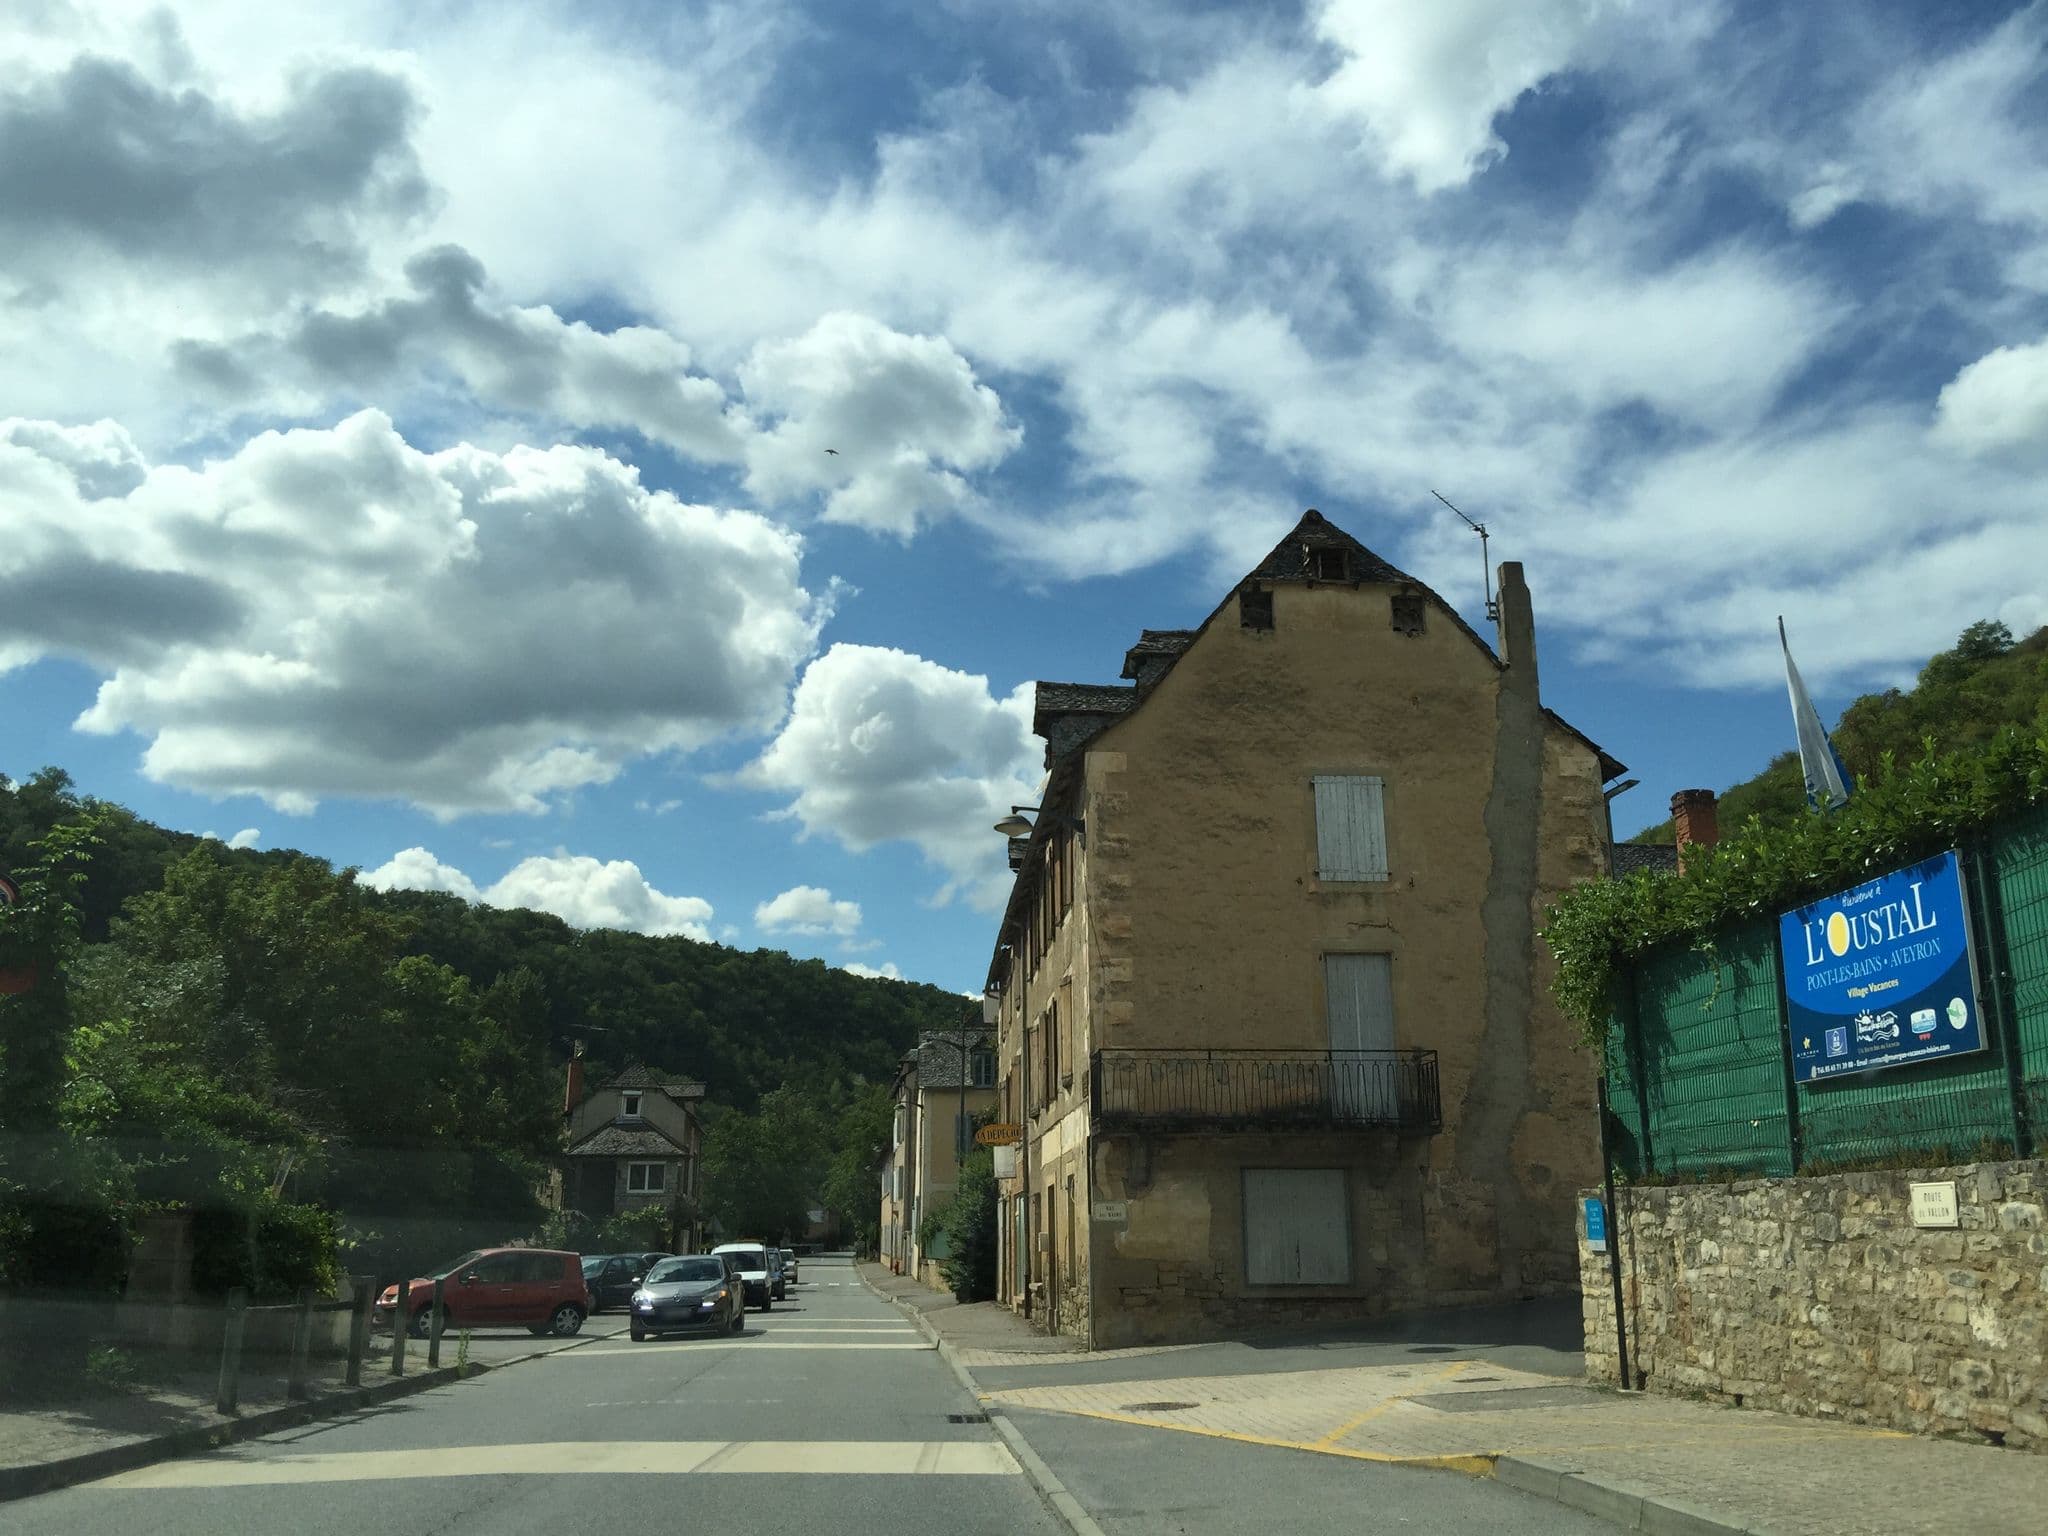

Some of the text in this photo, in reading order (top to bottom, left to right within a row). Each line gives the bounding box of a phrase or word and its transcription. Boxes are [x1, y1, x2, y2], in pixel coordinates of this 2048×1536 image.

[1804, 881, 1937, 966] L'OUSTAL
[1806, 937, 1941, 991] PONT-LES-BAINS AVEYRON
[1847, 978, 1899, 998] Village Vacances
